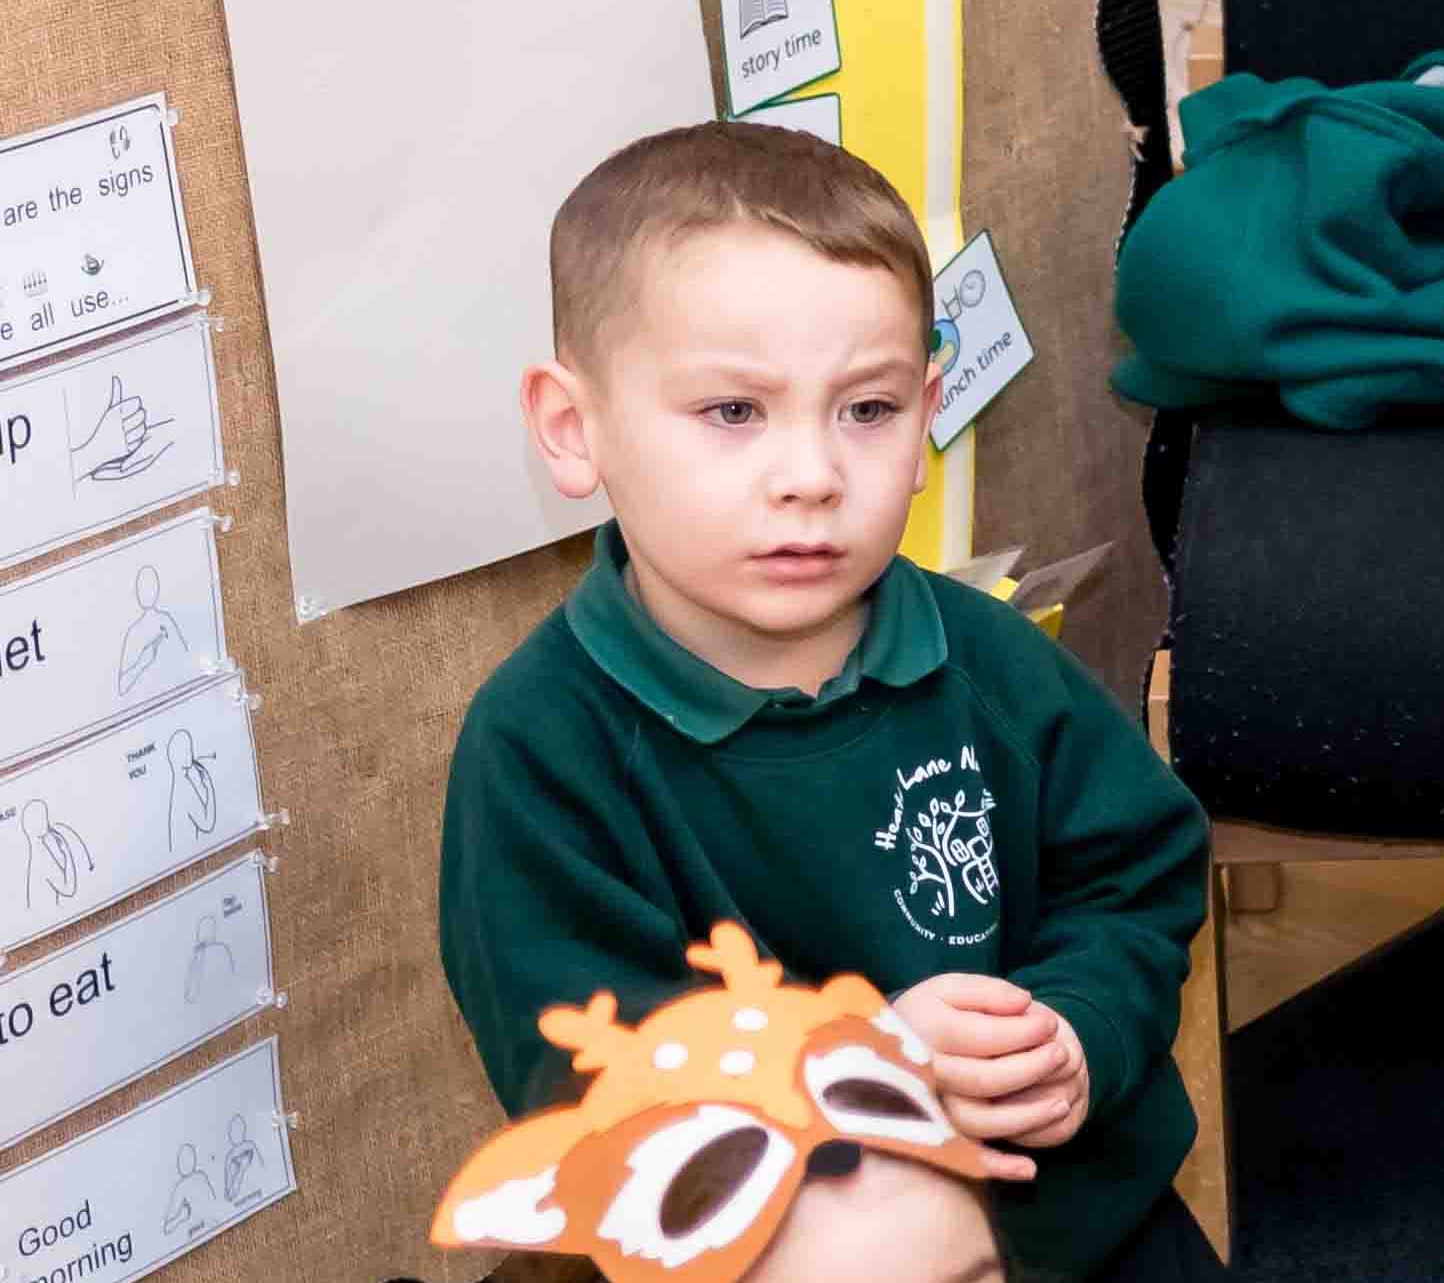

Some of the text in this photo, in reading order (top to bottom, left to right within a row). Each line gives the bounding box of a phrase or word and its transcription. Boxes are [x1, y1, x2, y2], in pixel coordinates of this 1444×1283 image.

[741, 29, 822, 78] story time
[3, 164, 154, 227] are the signs
[31, 301, 55, 332] all
[977, 331, 1013, 371] time
[0, 414, 31, 464] p
[0, 619, 46, 677] et
[896, 758, 952, 790] Lane
[50, 952, 115, 1017] eat
[18, 1200, 92, 1257] Good
